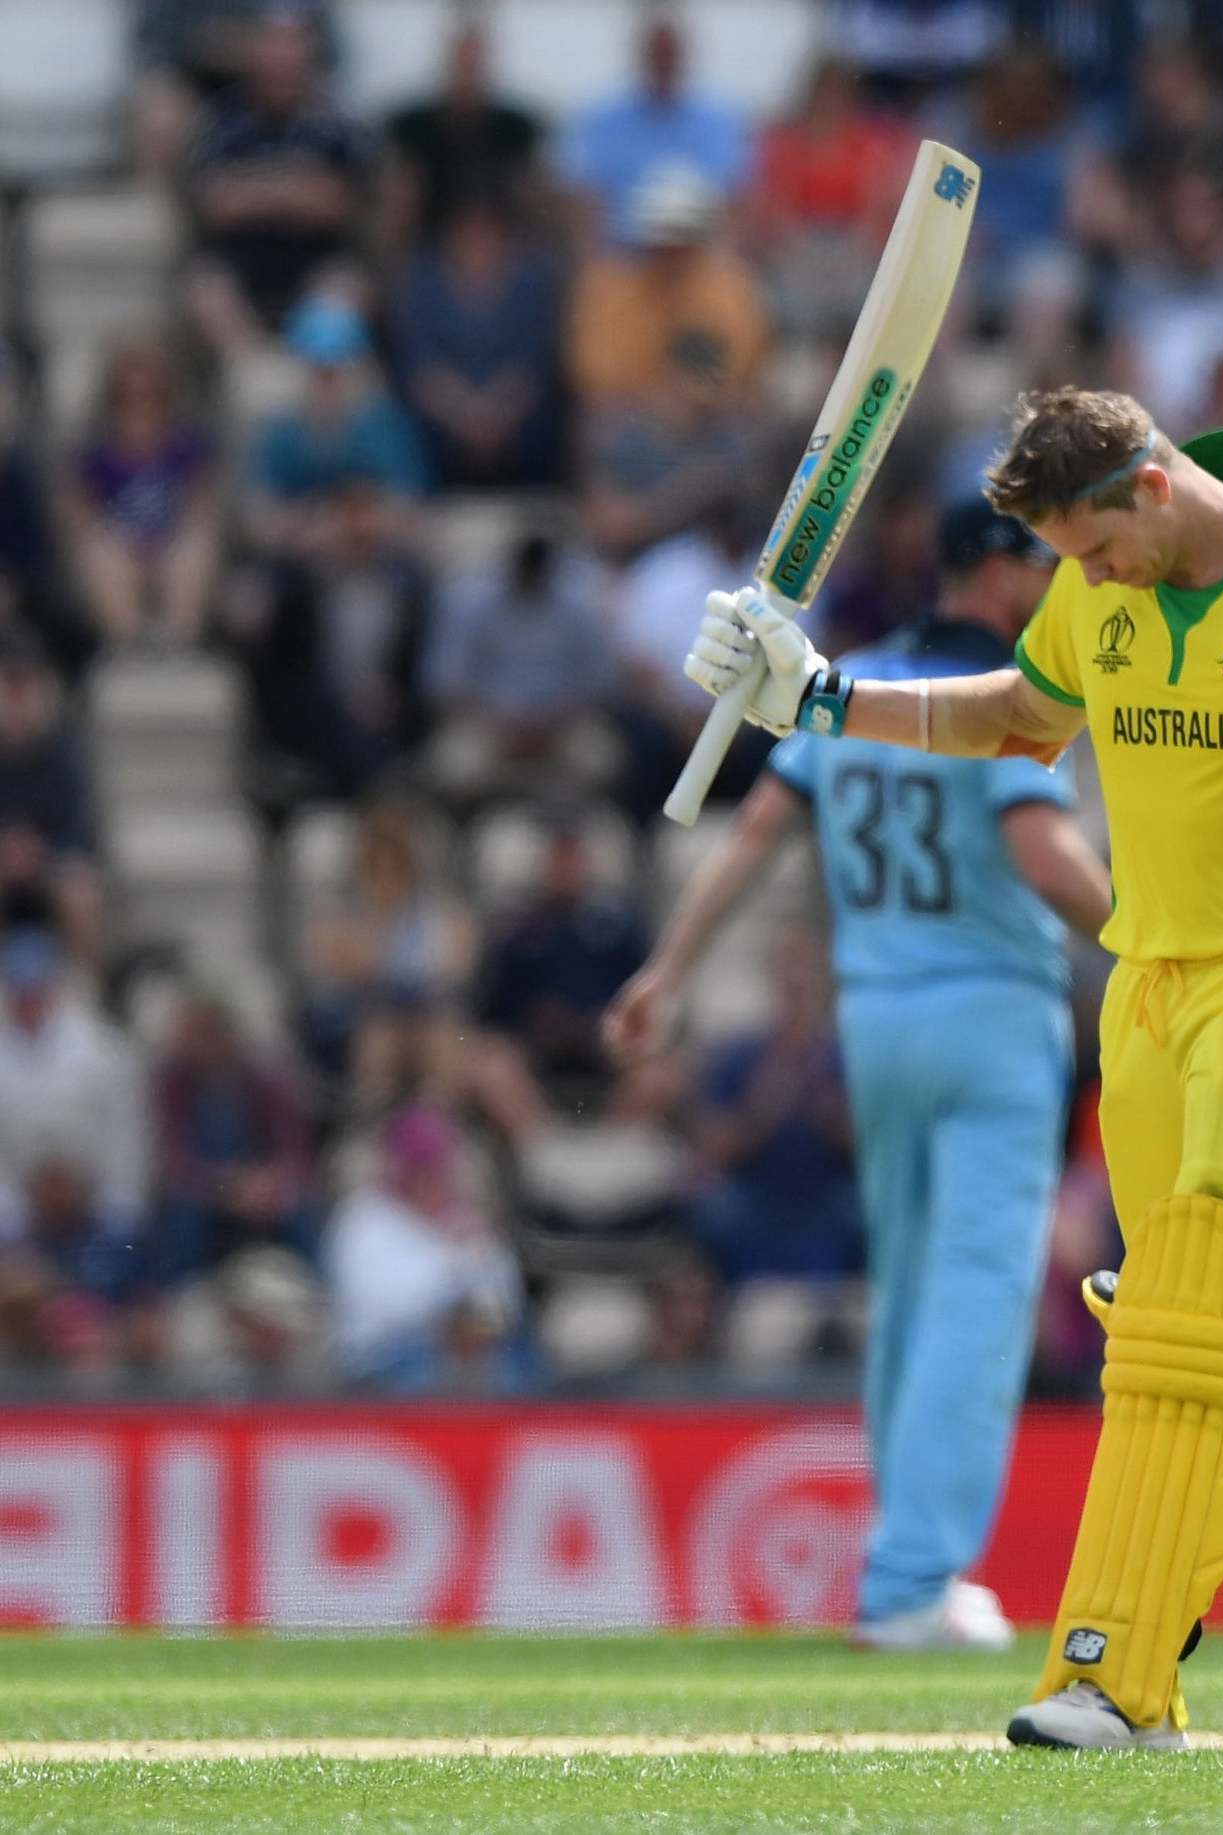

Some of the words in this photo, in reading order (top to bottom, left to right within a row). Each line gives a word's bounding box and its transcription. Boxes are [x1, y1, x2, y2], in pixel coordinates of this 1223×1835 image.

[780, 517, 819, 583] new
[810, 377, 891, 511] balance
[834, 765, 953, 916] 33
